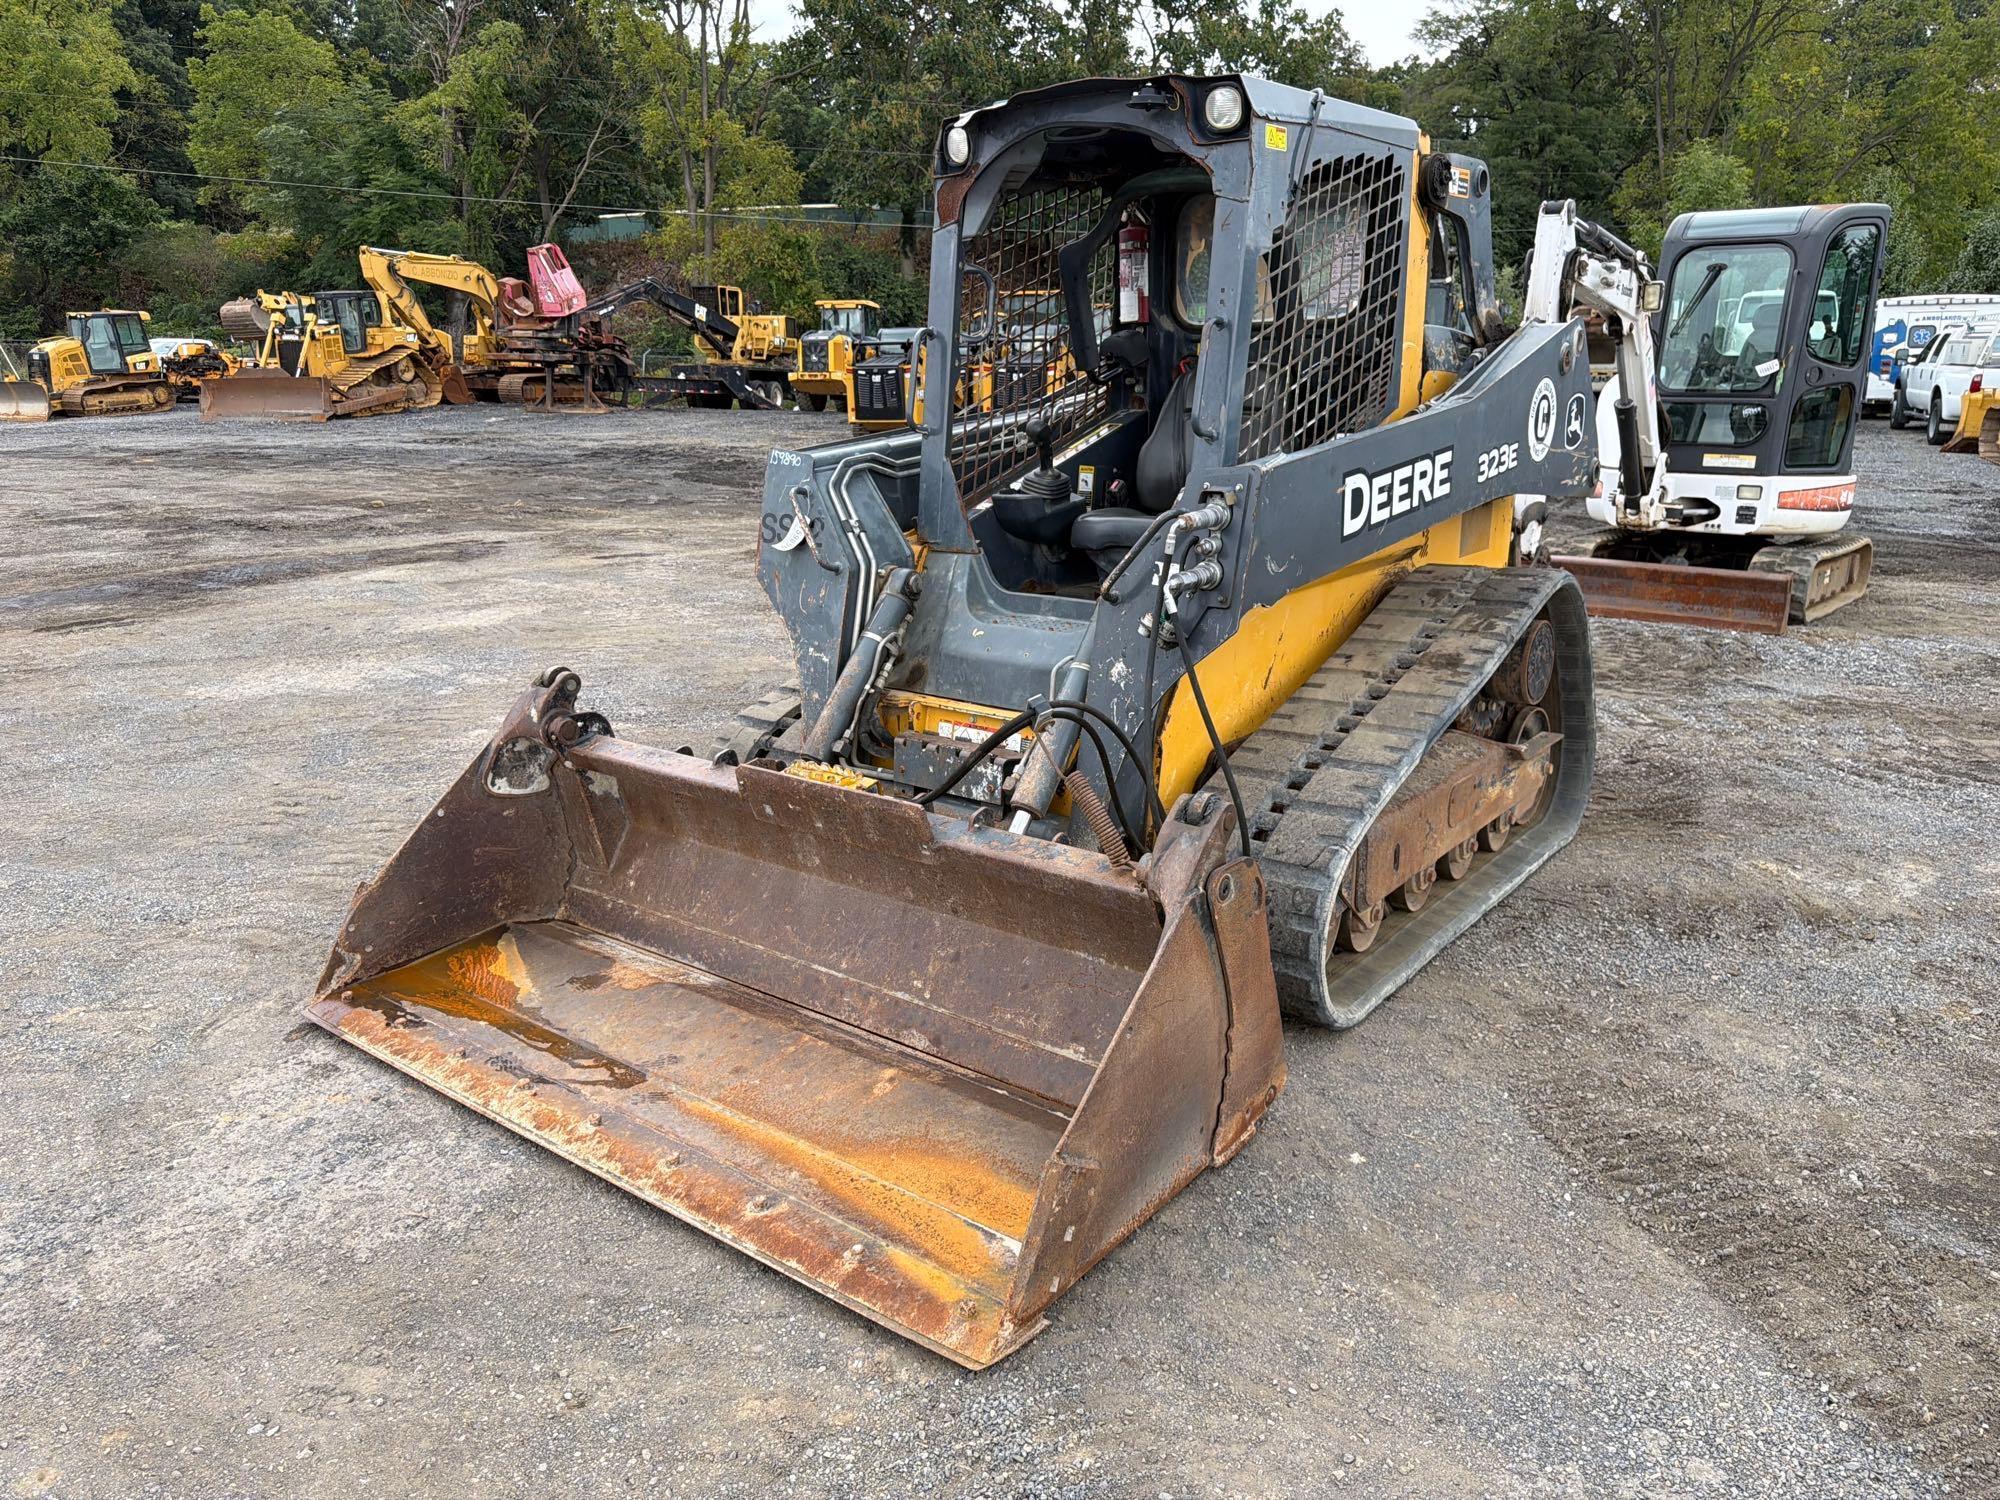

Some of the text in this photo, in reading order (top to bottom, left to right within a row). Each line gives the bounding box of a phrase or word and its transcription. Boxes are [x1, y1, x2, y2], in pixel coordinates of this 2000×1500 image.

[695, 303, 707, 321] CAT
[1537, 399, 1549, 438] C
[770, 450, 801, 466] 159890
[1477, 442, 1519, 483] 323E
[1343, 449, 1454, 537] DEERE
